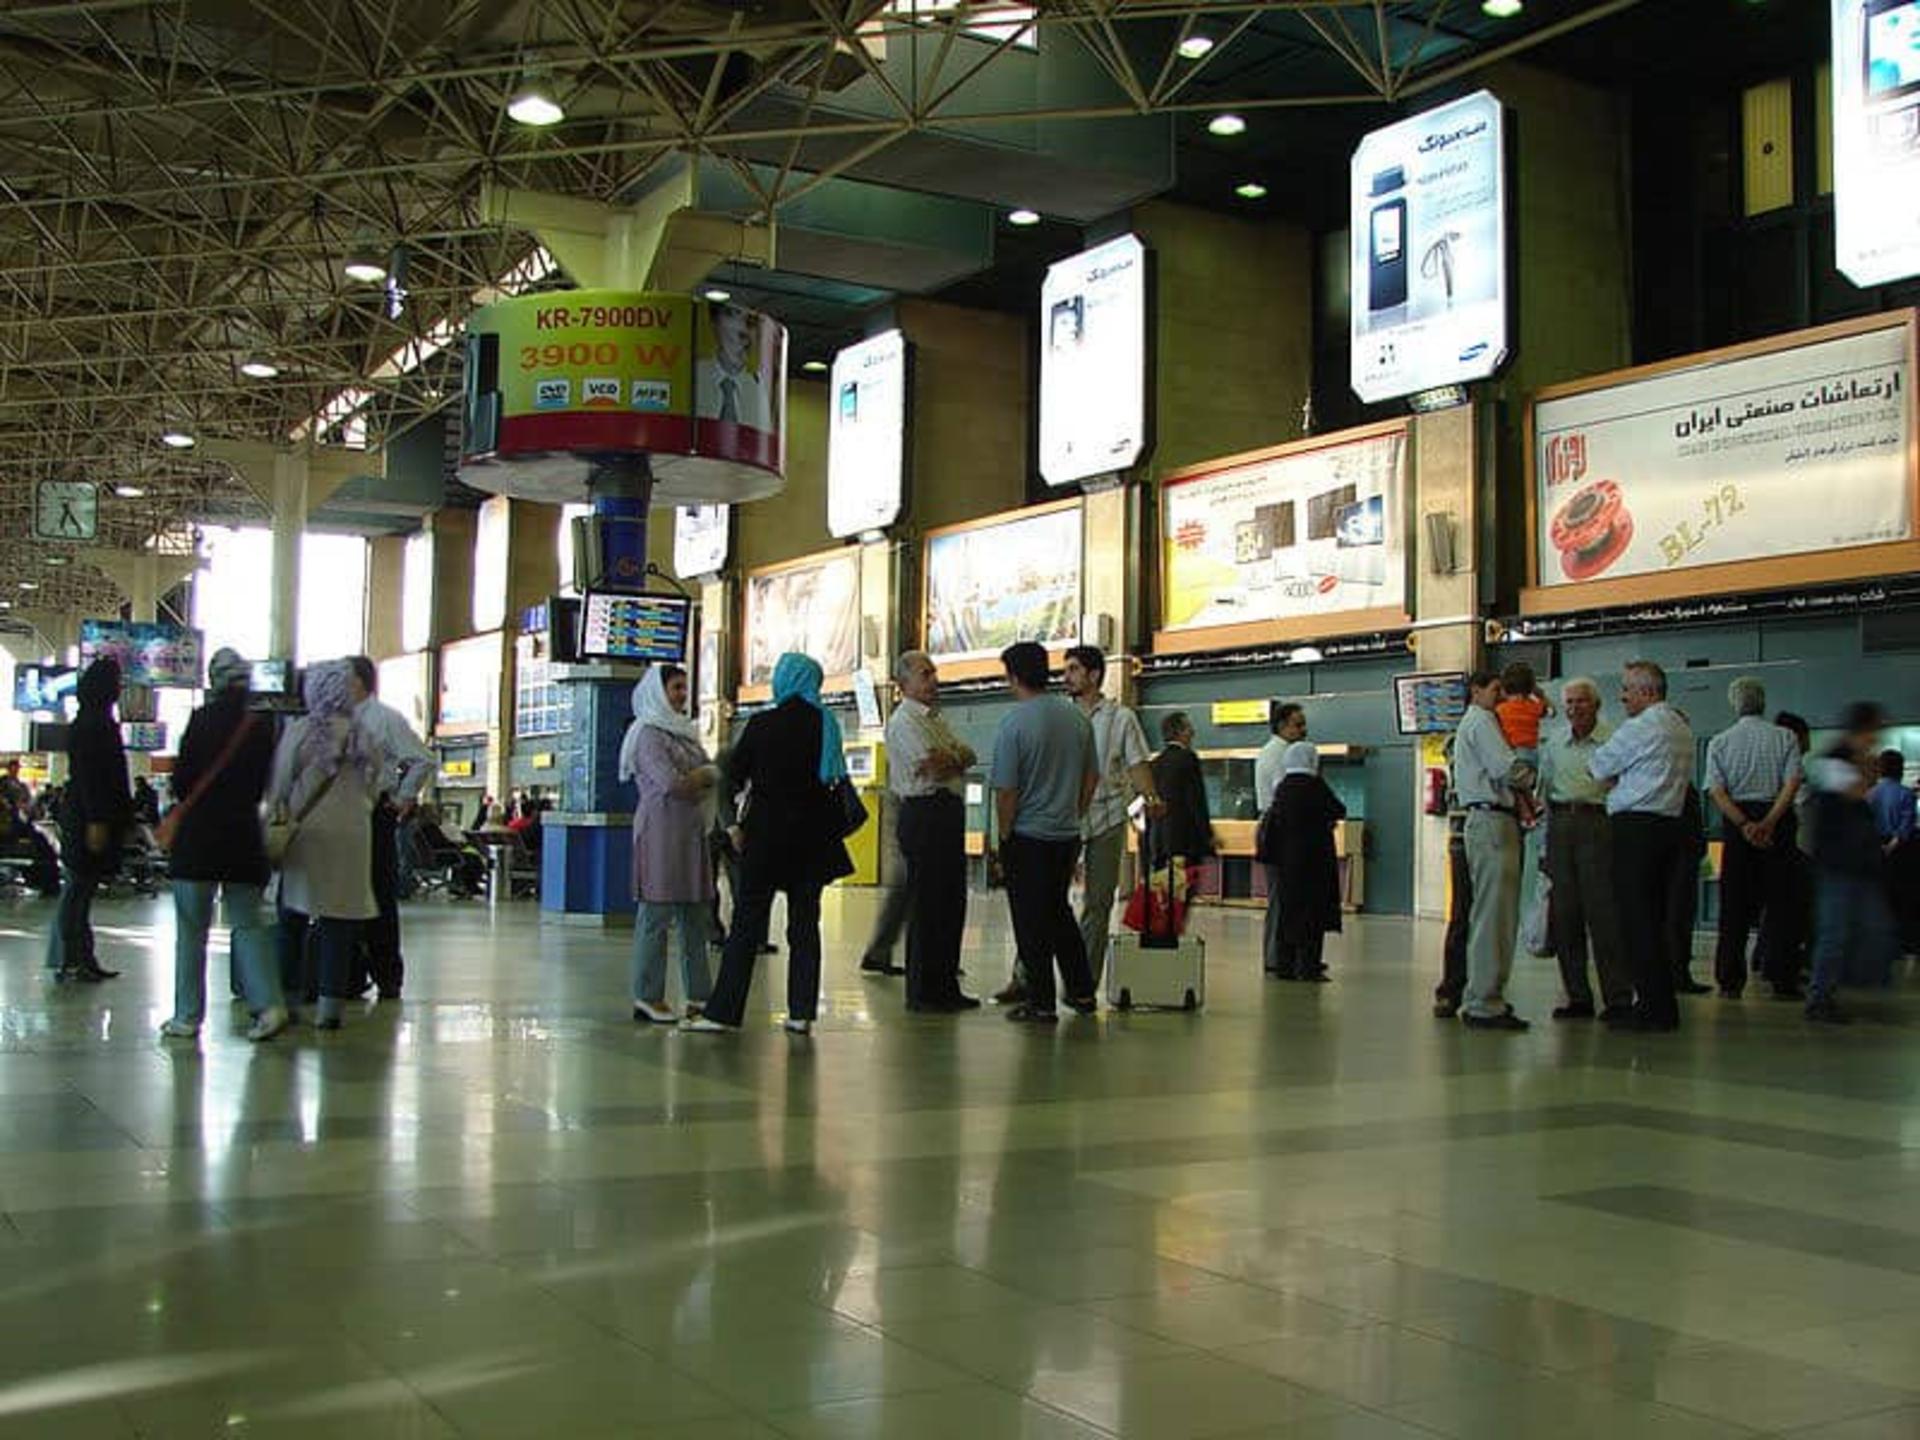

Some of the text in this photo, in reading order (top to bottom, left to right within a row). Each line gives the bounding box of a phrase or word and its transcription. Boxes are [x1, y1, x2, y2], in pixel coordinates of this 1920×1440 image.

[536, 306, 673, 330] KR-7900DV
[520, 342, 681, 372] 3900 W
[588, 383, 618, 395] VCD
[1801, 371, 1901, 411] ارتعاشات
[1674, 406, 1722, 439] ایران
[1725, 398, 1795, 429] صنعتی
[1657, 482, 1746, 566] BL-72
